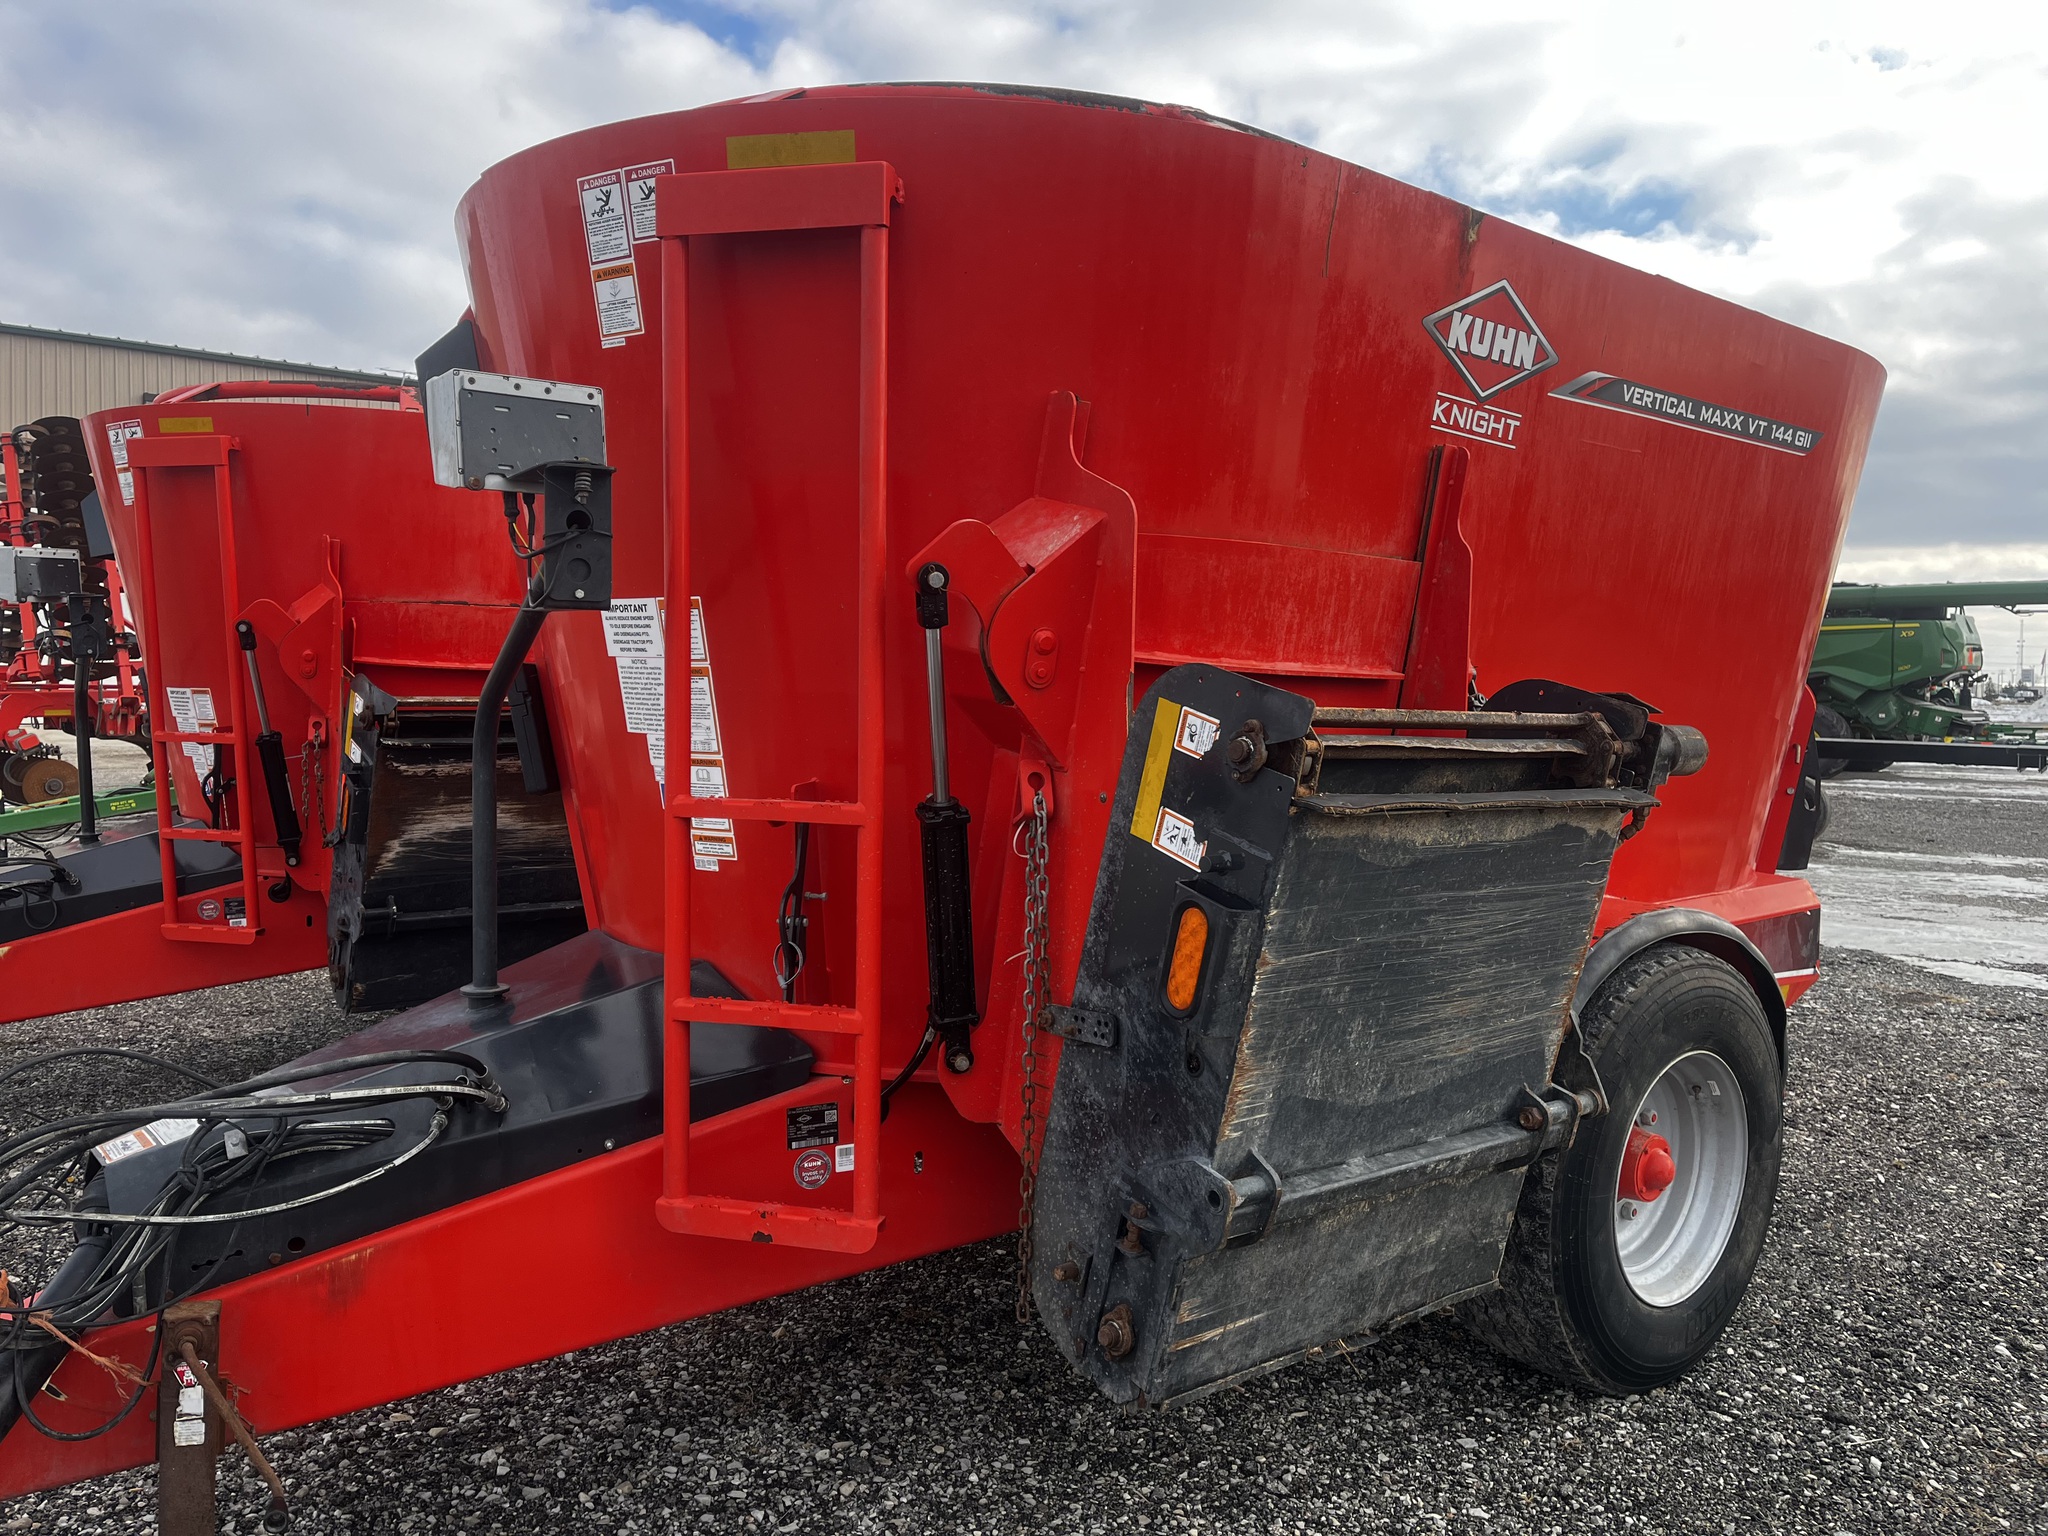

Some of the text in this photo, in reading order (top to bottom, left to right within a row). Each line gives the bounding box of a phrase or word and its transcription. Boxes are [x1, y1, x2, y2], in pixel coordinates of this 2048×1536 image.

[590, 174, 617, 188] DANGER
[638, 165, 666, 178] DANGER
[602, 266, 630, 278] WARNING
[1447, 310, 1538, 371] KUHN
[1432, 399, 1521, 441] KNIGHT
[1623, 384, 1696, 419] VERTICAL
[1699, 405, 1743, 431] MAXX
[1748, 417, 1768, 436] VT
[1771, 424, 1793, 444] 144
